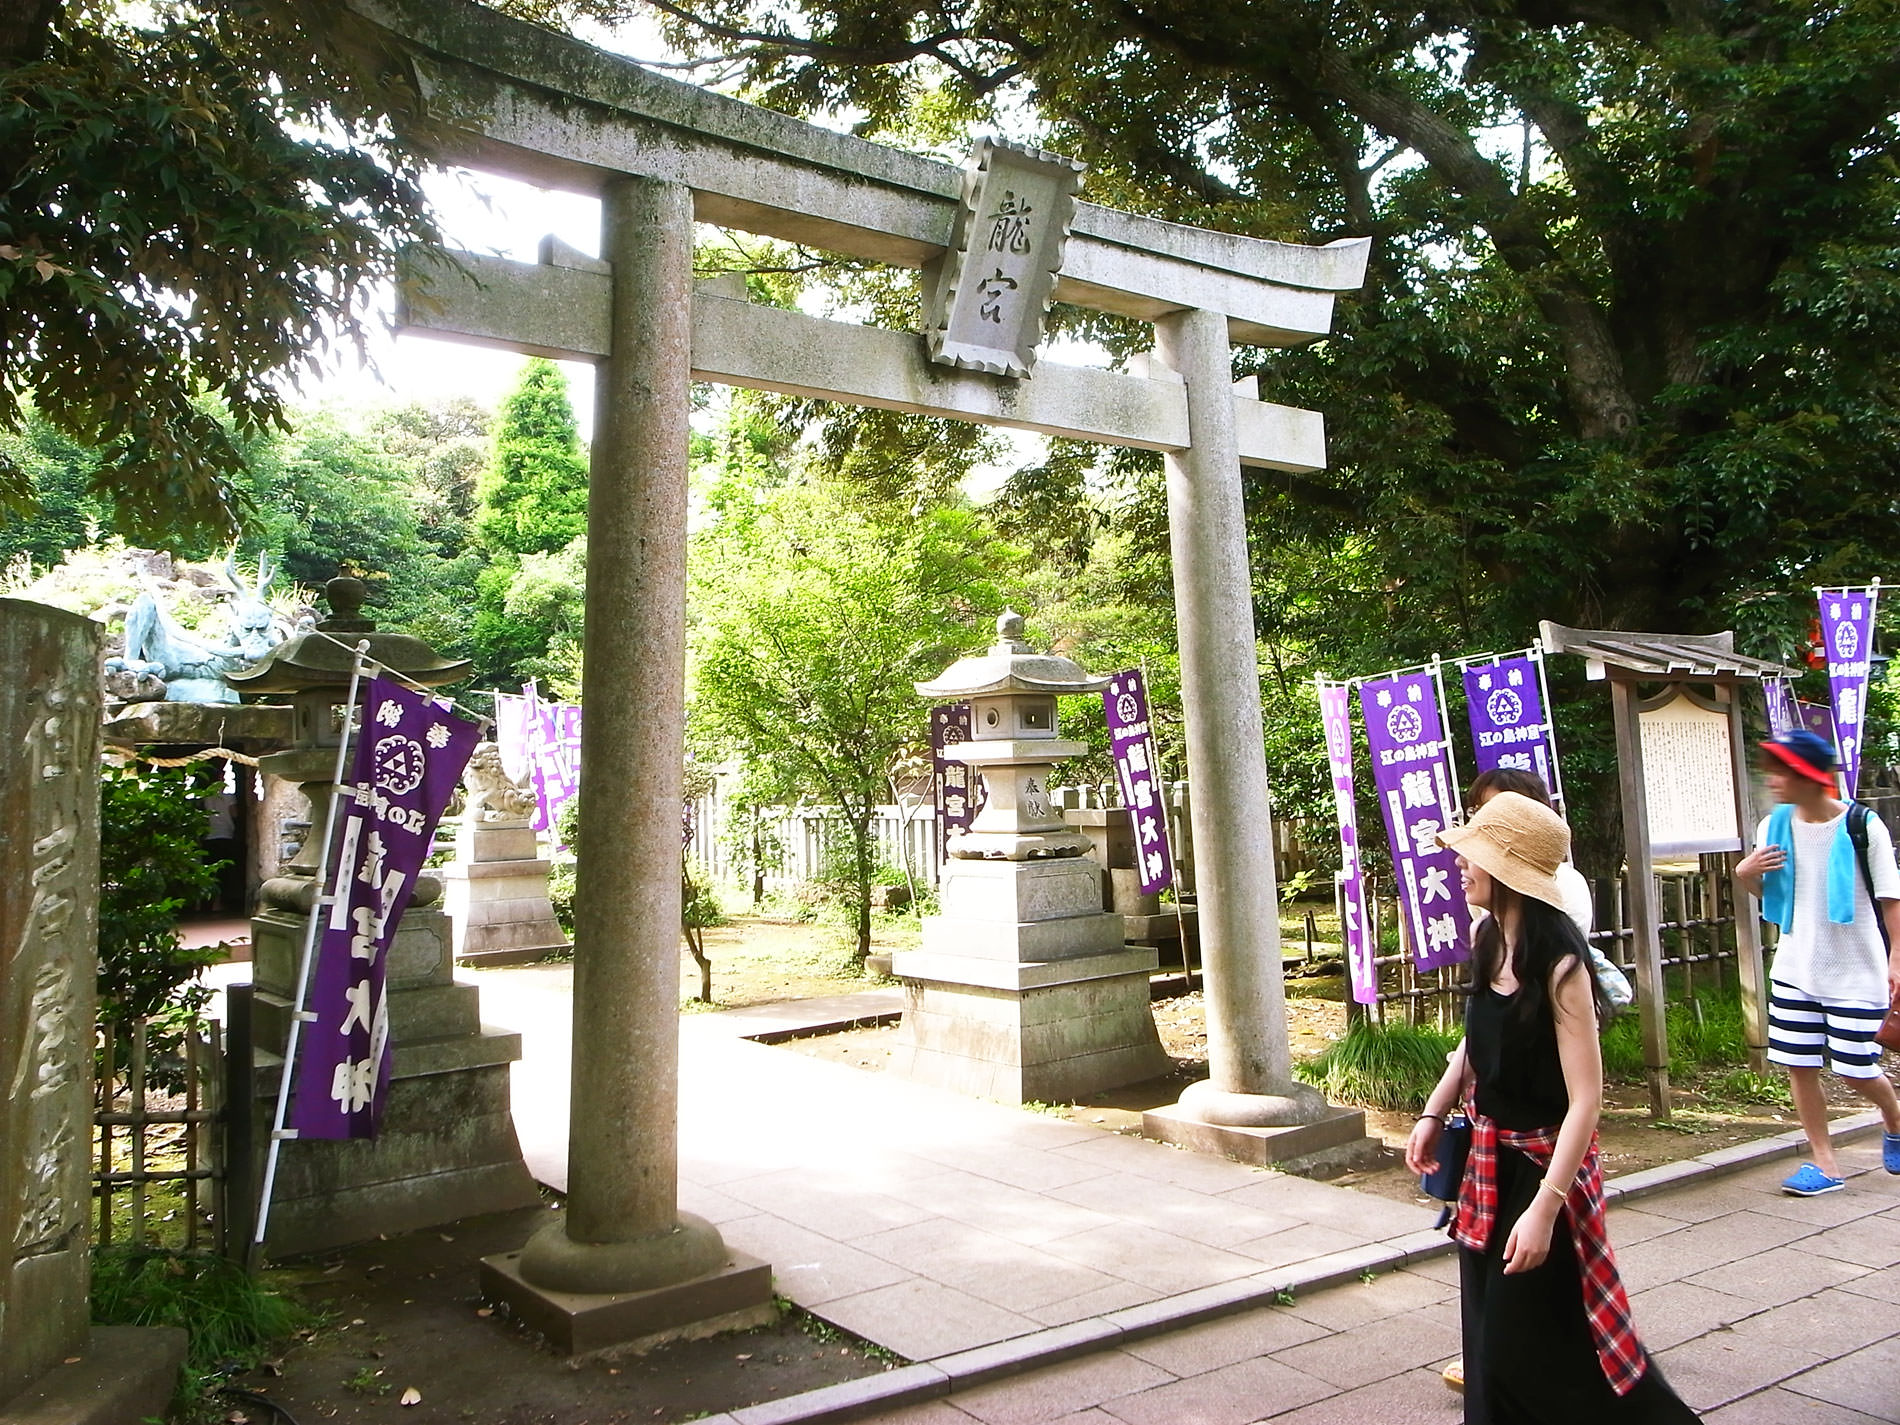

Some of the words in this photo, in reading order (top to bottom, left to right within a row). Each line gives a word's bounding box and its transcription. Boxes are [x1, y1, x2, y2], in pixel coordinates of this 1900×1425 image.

[977, 190, 1032, 324] 龍宮
[1401, 769, 1458, 953] 龍宮大神
